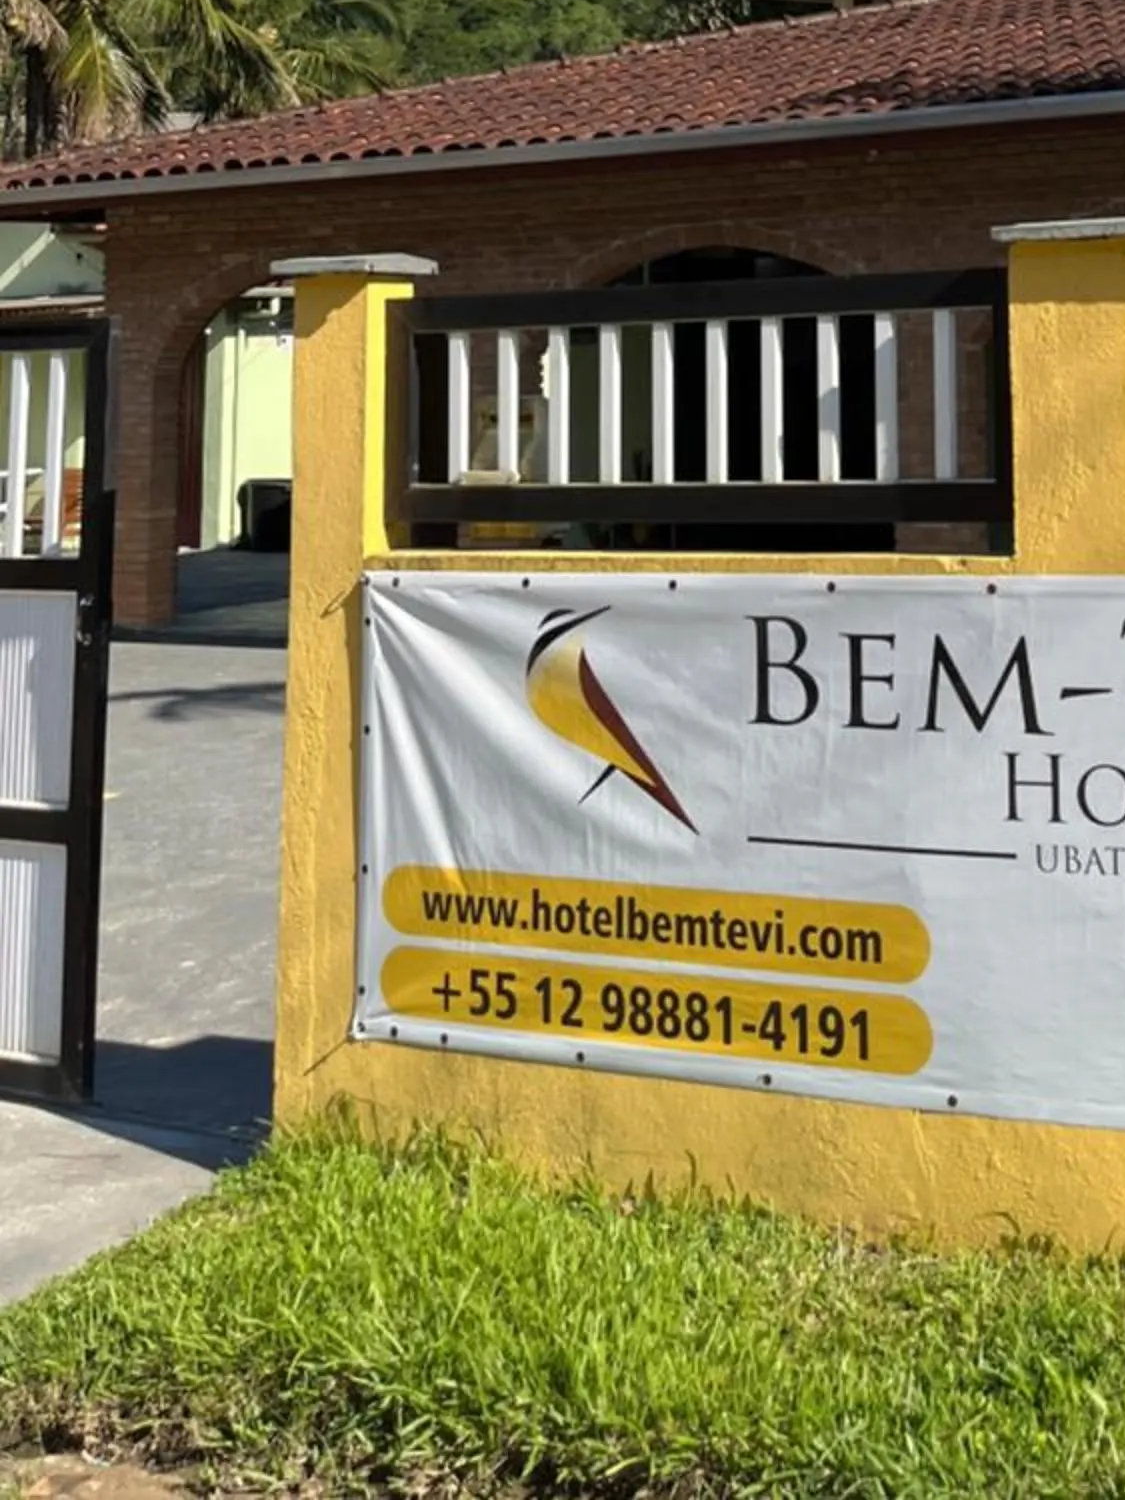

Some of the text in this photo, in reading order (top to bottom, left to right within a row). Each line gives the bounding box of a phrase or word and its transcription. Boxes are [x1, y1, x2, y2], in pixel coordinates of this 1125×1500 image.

[421, 887, 883, 965] www.hotelbemtevi.com
[431, 969, 871, 1062] +55 12 98881-4191
